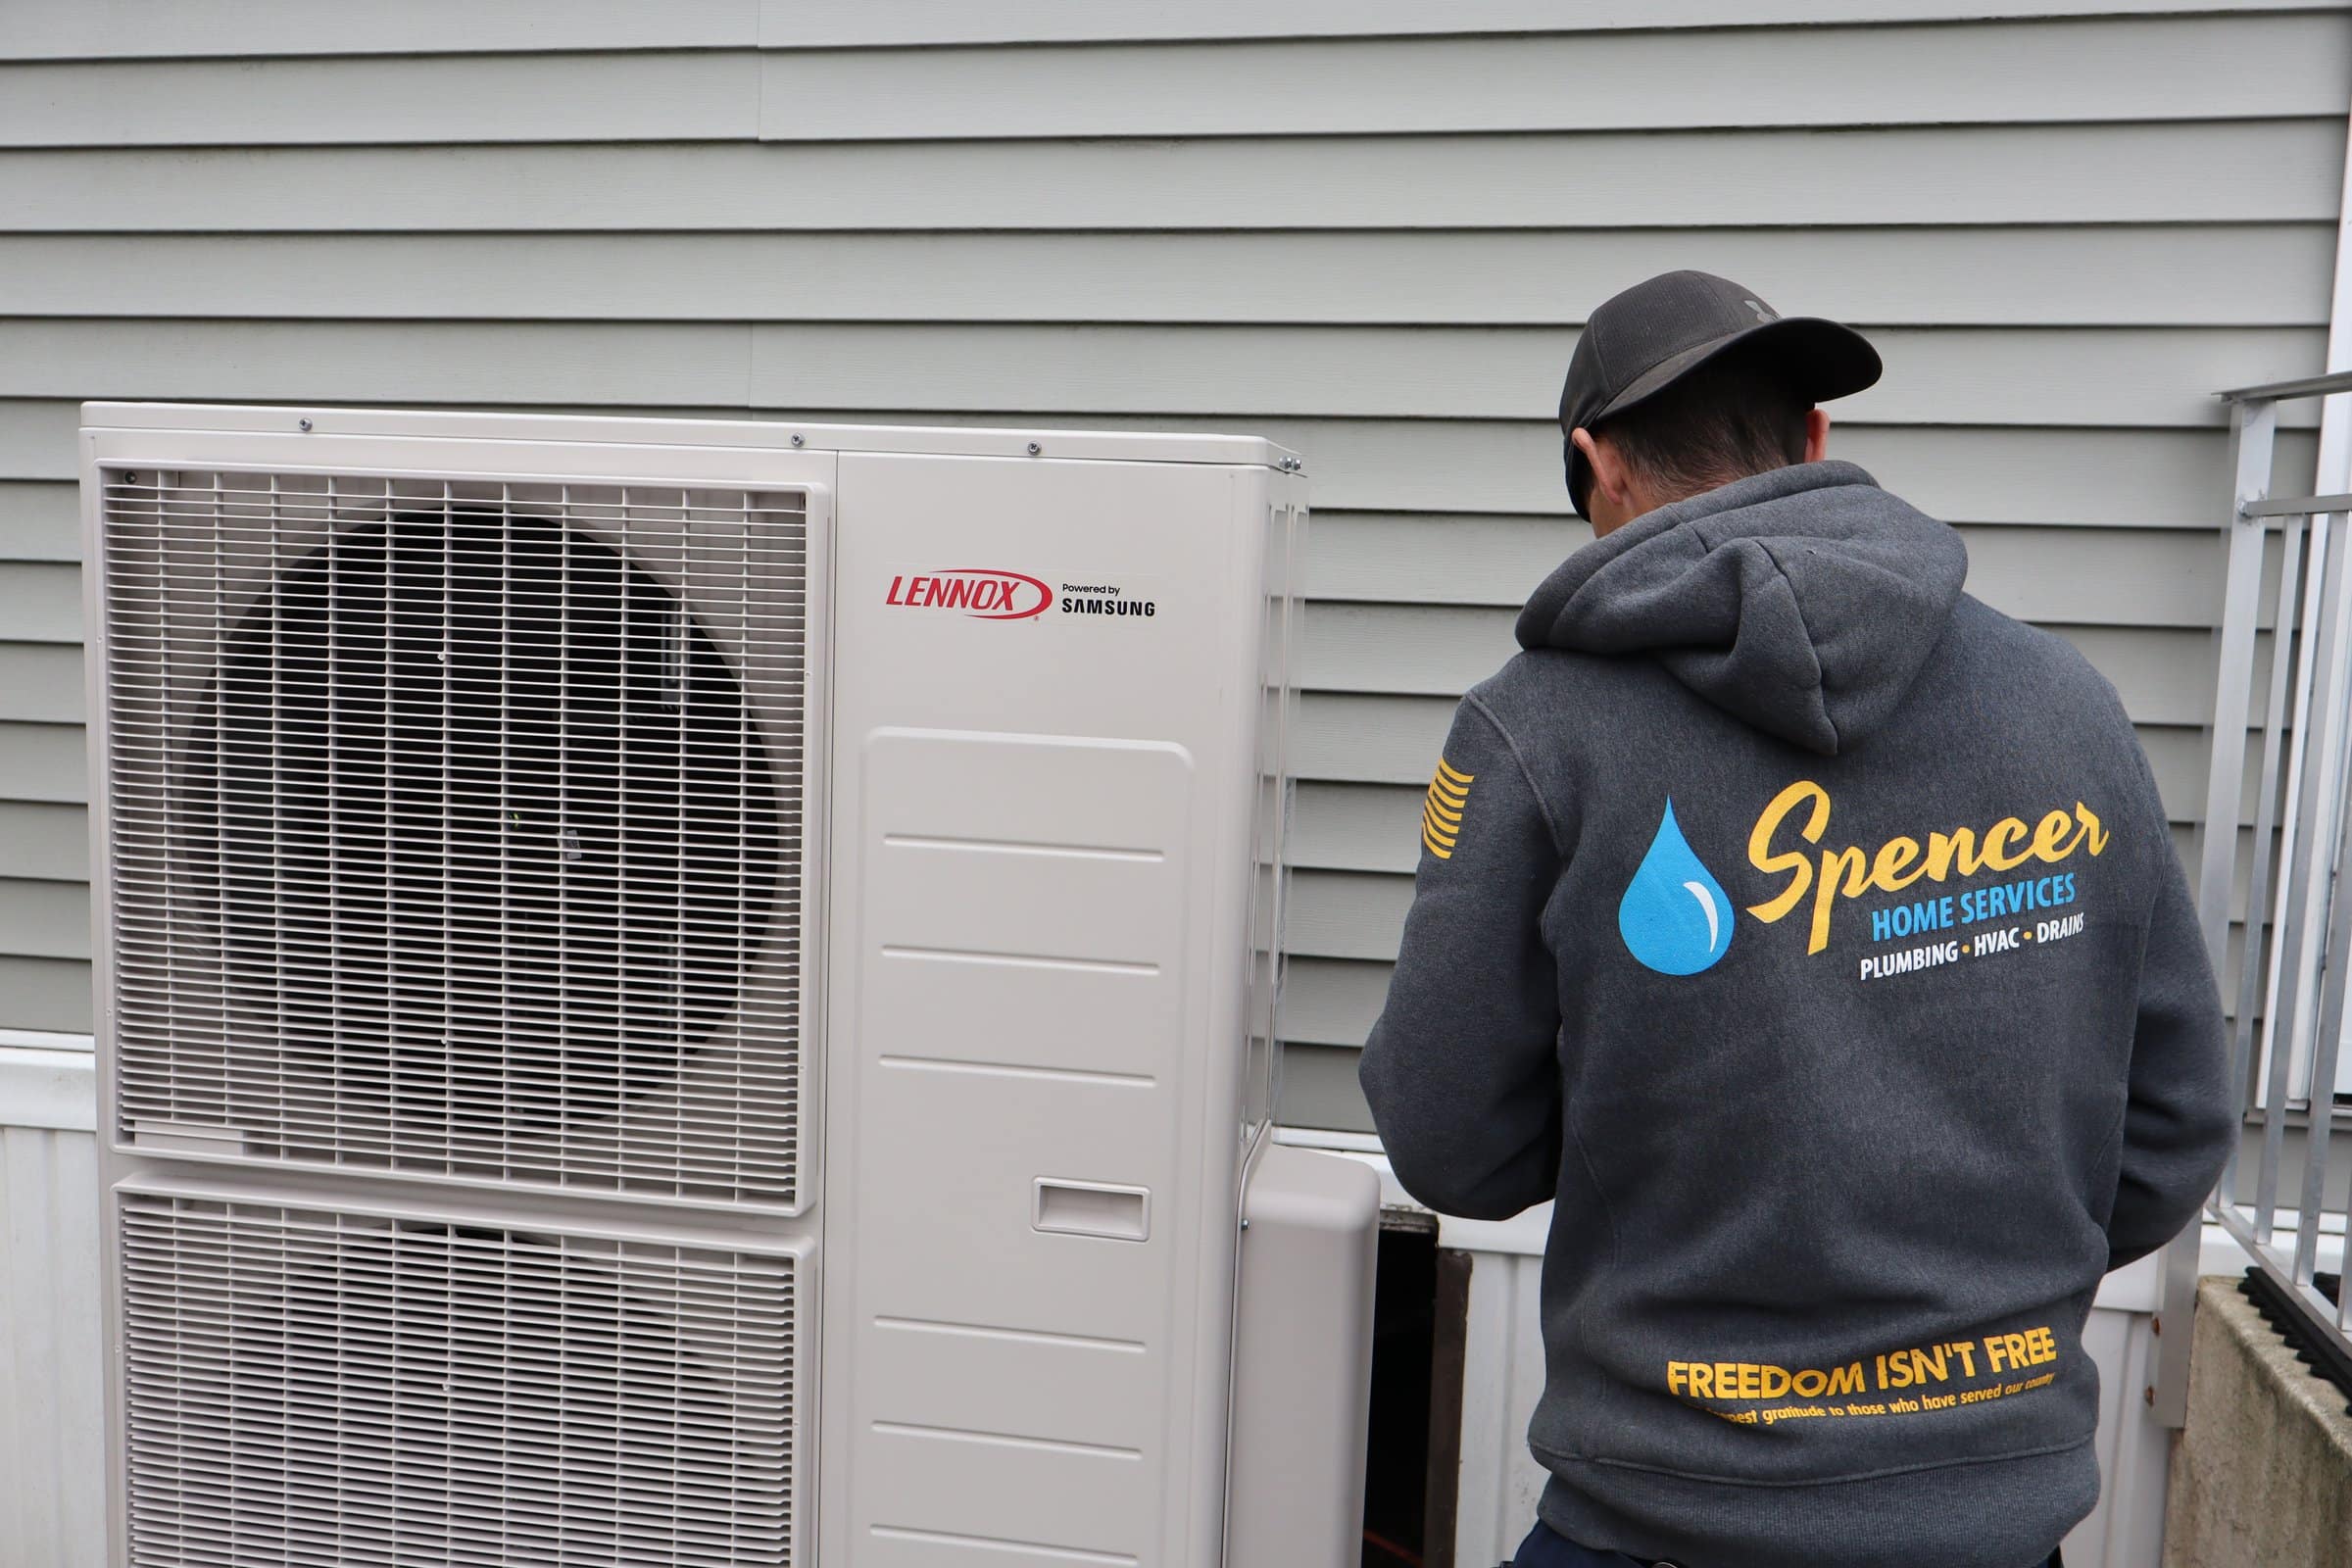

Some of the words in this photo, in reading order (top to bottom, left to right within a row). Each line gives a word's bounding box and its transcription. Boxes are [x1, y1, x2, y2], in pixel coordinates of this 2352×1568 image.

[886, 575, 1019, 612] LENNOX
[1061, 583, 1105, 594] Powered
[1107, 585, 1121, 597] by
[1061, 598, 1155, 617] SAMSUNG
[1746, 780, 2110, 956] Spencer
[1871, 896, 1955, 942] HOME
[1960, 872, 2077, 924] SERVICES
[1860, 941, 1959, 981] PLUMBING
[1974, 927, 2020, 957] HVAC
[2036, 912, 2084, 945] DRAINS
[1666, 1360, 1867, 1399] FREEDOM
[1876, 1341, 1976, 1391] ISN'T
[1983, 1326, 2057, 1374] FREE
[1762, 1404, 1827, 1426] gratitude
[1828, 1406, 1845, 1417] to
[1846, 1402, 1886, 1417] those
[1888, 1396, 1920, 1415] who
[1921, 1394, 1957, 1411] have
[1960, 1383, 2002, 1404] served
[2004, 1382, 2024, 1396] our
